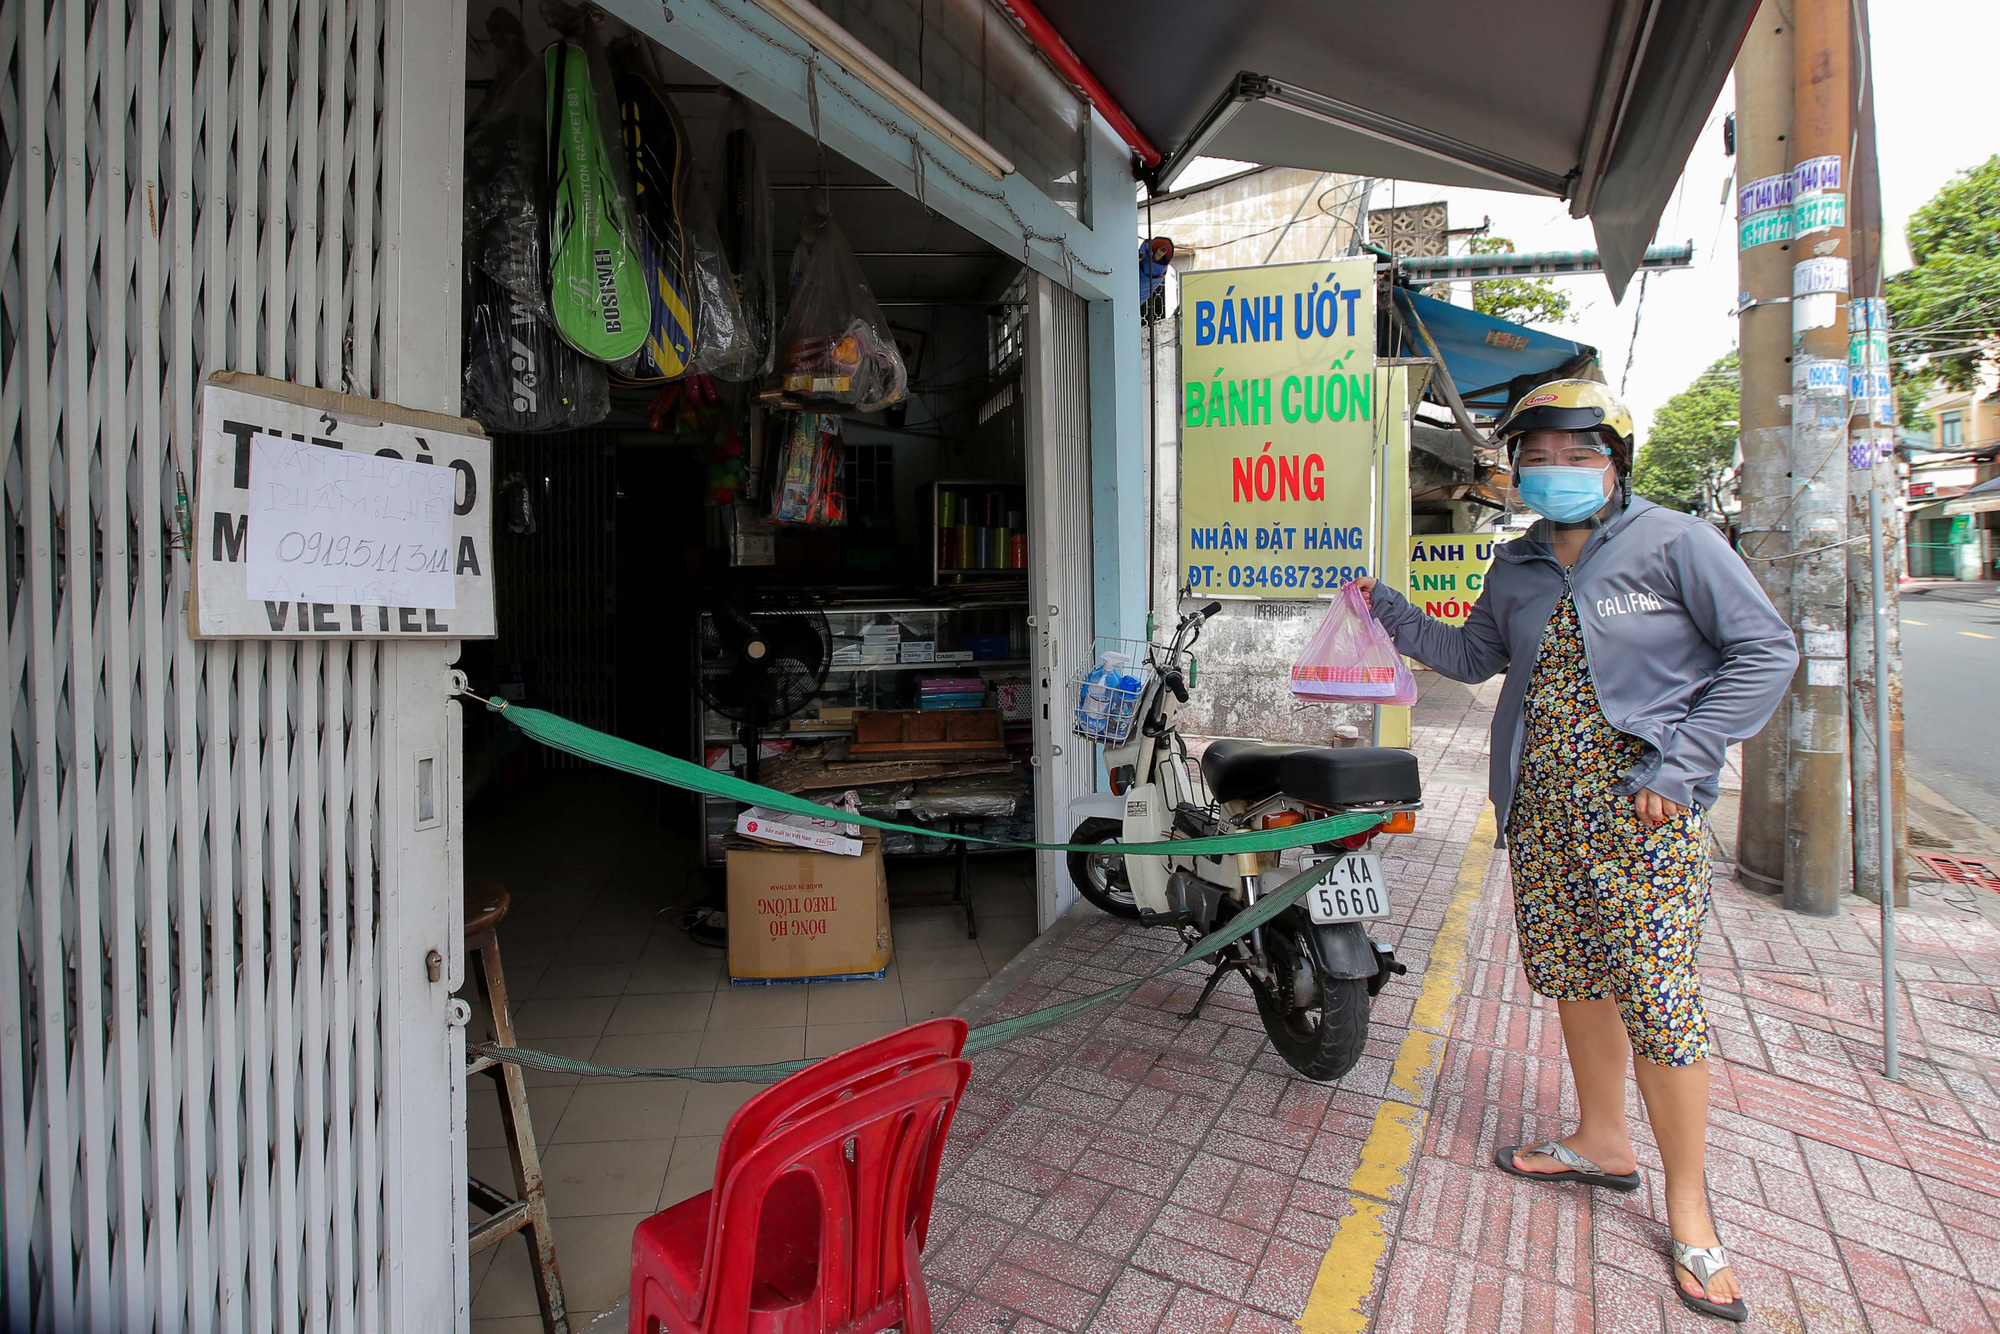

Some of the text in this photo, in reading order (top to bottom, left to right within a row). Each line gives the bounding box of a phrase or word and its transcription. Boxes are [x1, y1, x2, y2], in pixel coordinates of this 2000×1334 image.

[566, 86, 579, 107] 881
[569, 111, 588, 161] RACKET
[594, 248, 623, 334] BOSIWEI
[1195, 272, 1362, 346] BÁNH ƯỚT
[1185, 350, 1371, 428] BÁNH CUỐN
[256, 440, 327, 475] VĂN
[1232, 441, 1326, 503] NÓNG
[1191, 521, 1363, 556] NHẬN ĐẶT HÀNG
[1411, 541, 1464, 562] ÁNH
[1188, 564, 1222, 588] ĐT:
[1410, 570, 1456, 591] ÁNH
[1597, 592, 1662, 618] CALIFAA
[757, 896, 837, 918] TREO TƯỜNG
[1319, 887, 1380, 918] 5660
[770, 919, 827, 942] ĐỒNG HỒ
